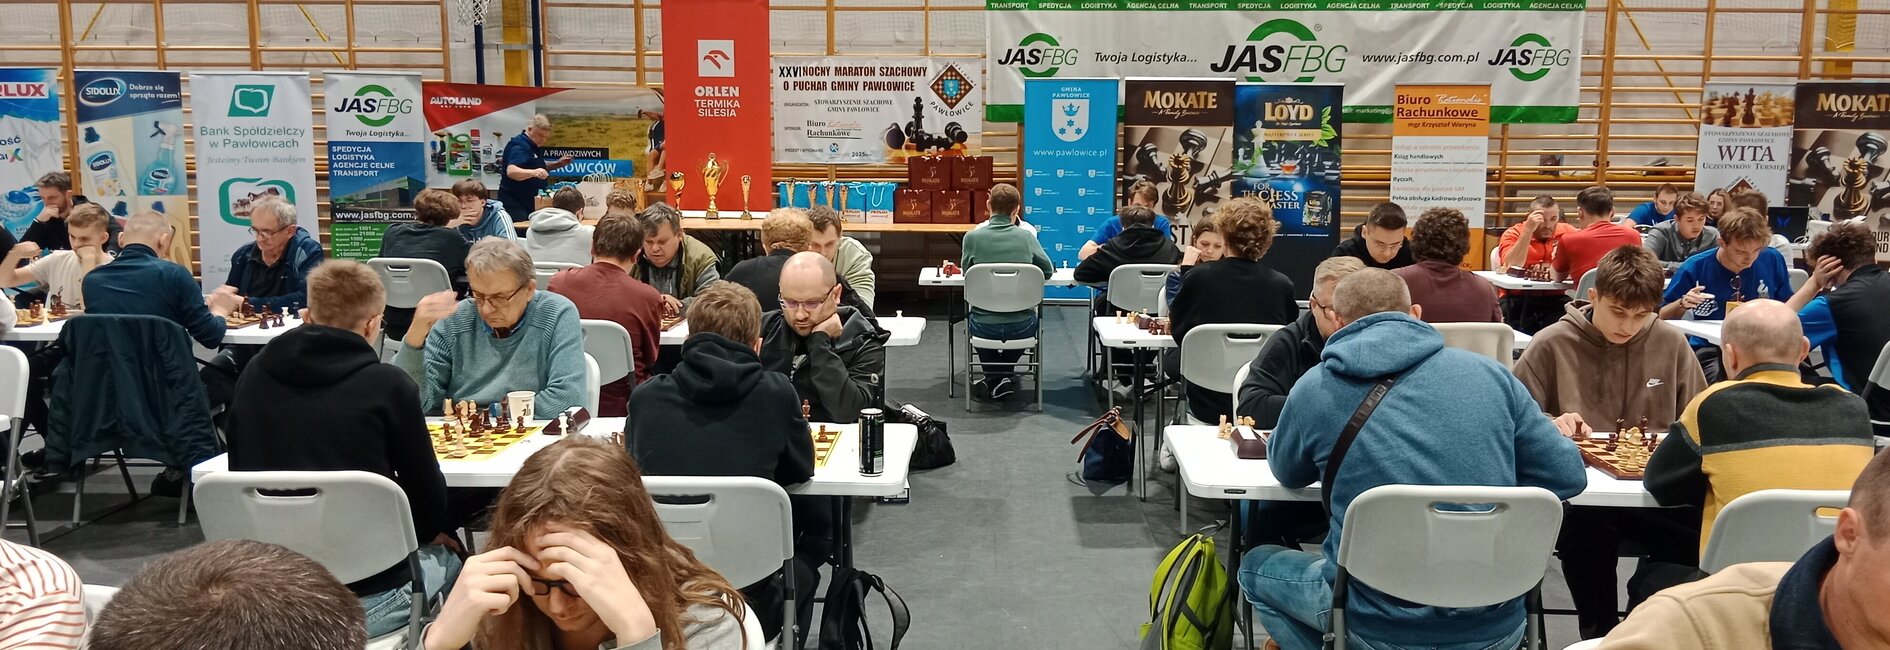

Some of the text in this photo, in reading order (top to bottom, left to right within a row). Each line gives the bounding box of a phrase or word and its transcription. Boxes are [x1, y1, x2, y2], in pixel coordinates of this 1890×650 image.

[1094, 52, 1197, 64] Twoja Logistyka...
[1362, 52, 1480, 64] www.jasfbg.com.pl
[779, 66, 928, 78] XXVI NOCNY MARATON SZACHOWY
[86, 86, 121, 96] SIDOLUX
[130, 83, 164, 92] Dobrze się
[694, 86, 740, 97] ORLEN
[784, 80, 915, 92] O PUCHAR GMINY PAWŁOWICE
[430, 97, 482, 106] AUTOLAND
[694, 100, 740, 108] TERMIKA
[1144, 91, 1218, 108] MOKATE
[1397, 94, 1431, 104] Biuro
[1816, 93, 1890, 112] MOKAT
[698, 109, 736, 117] SILESIA
[930, 101, 974, 116] PAWŁOWICE
[1264, 102, 1314, 121] LOYD
[1396, 107, 1478, 117] Rachunkowe
[200, 126, 305, 138] Bank Spółdzielczy
[223, 139, 298, 148] Pawłowicach
[550, 150, 602, 158] PRAWDZIWYCH
[1034, 149, 1108, 157] www.pawlowice.pl
[1718, 145, 1775, 162] WITA
[1258, 190, 1298, 202] CHESS
